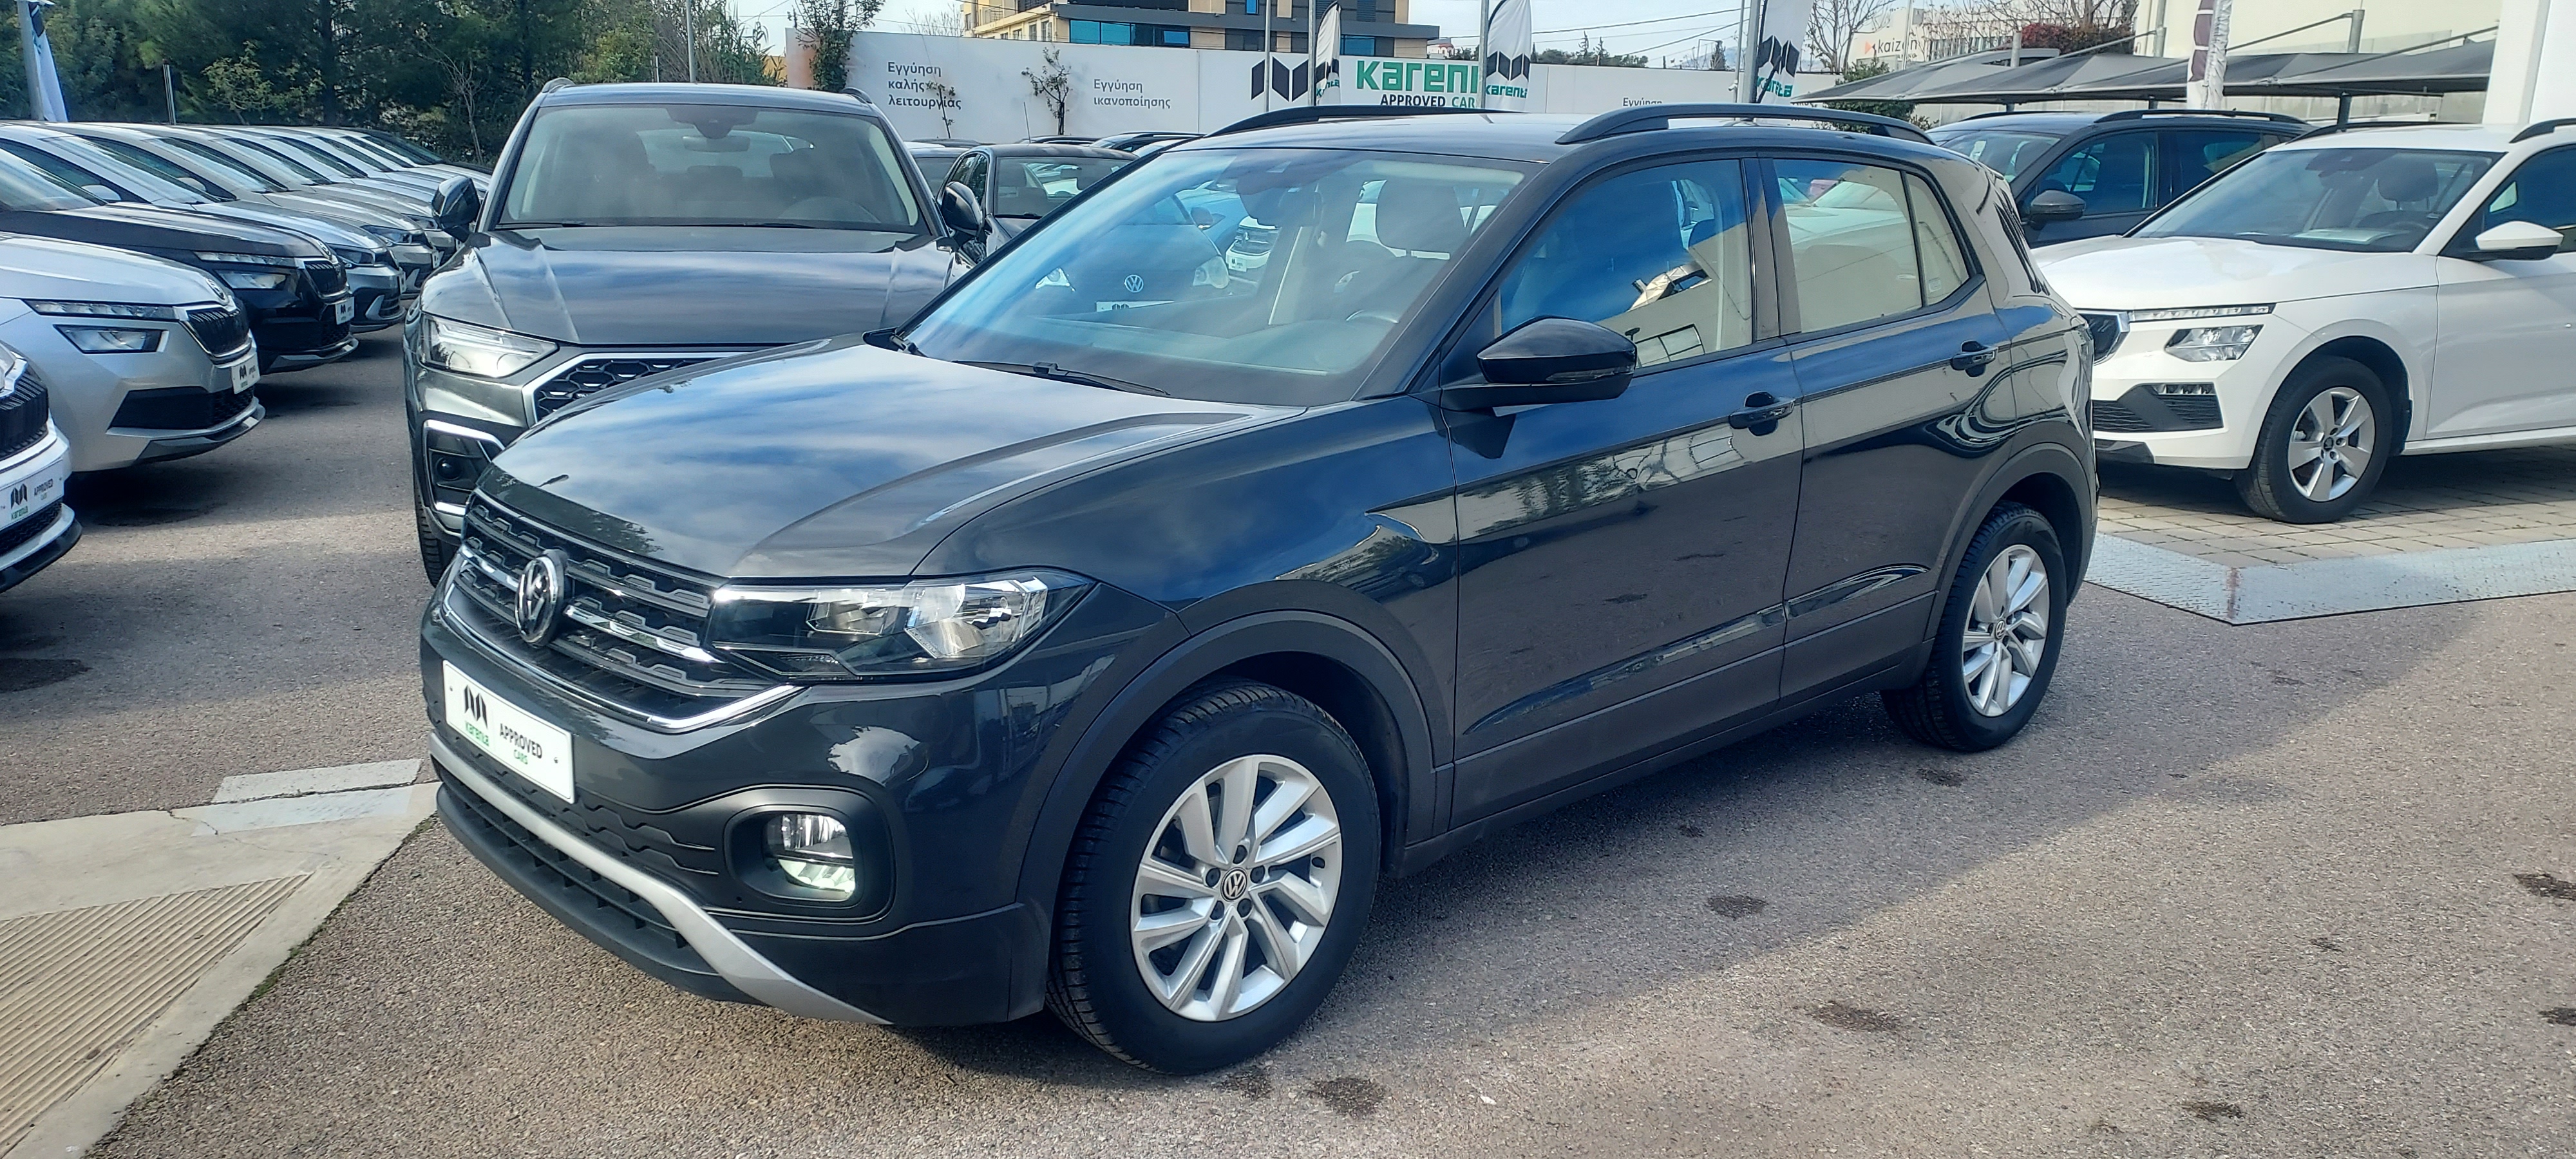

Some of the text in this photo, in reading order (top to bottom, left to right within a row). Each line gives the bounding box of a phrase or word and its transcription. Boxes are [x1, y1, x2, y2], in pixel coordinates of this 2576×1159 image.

[888, 62, 941, 77] Εγγύηση
[889, 79, 924, 93] καλής
[1094, 79, 1142, 93] Εγγύηση
[889, 94, 961, 110] λειτουργίας
[1094, 95, 1171, 109] ικανοποίησης
[1380, 94, 1446, 107] APPROVED
[499, 722, 543, 759] APPROVED
